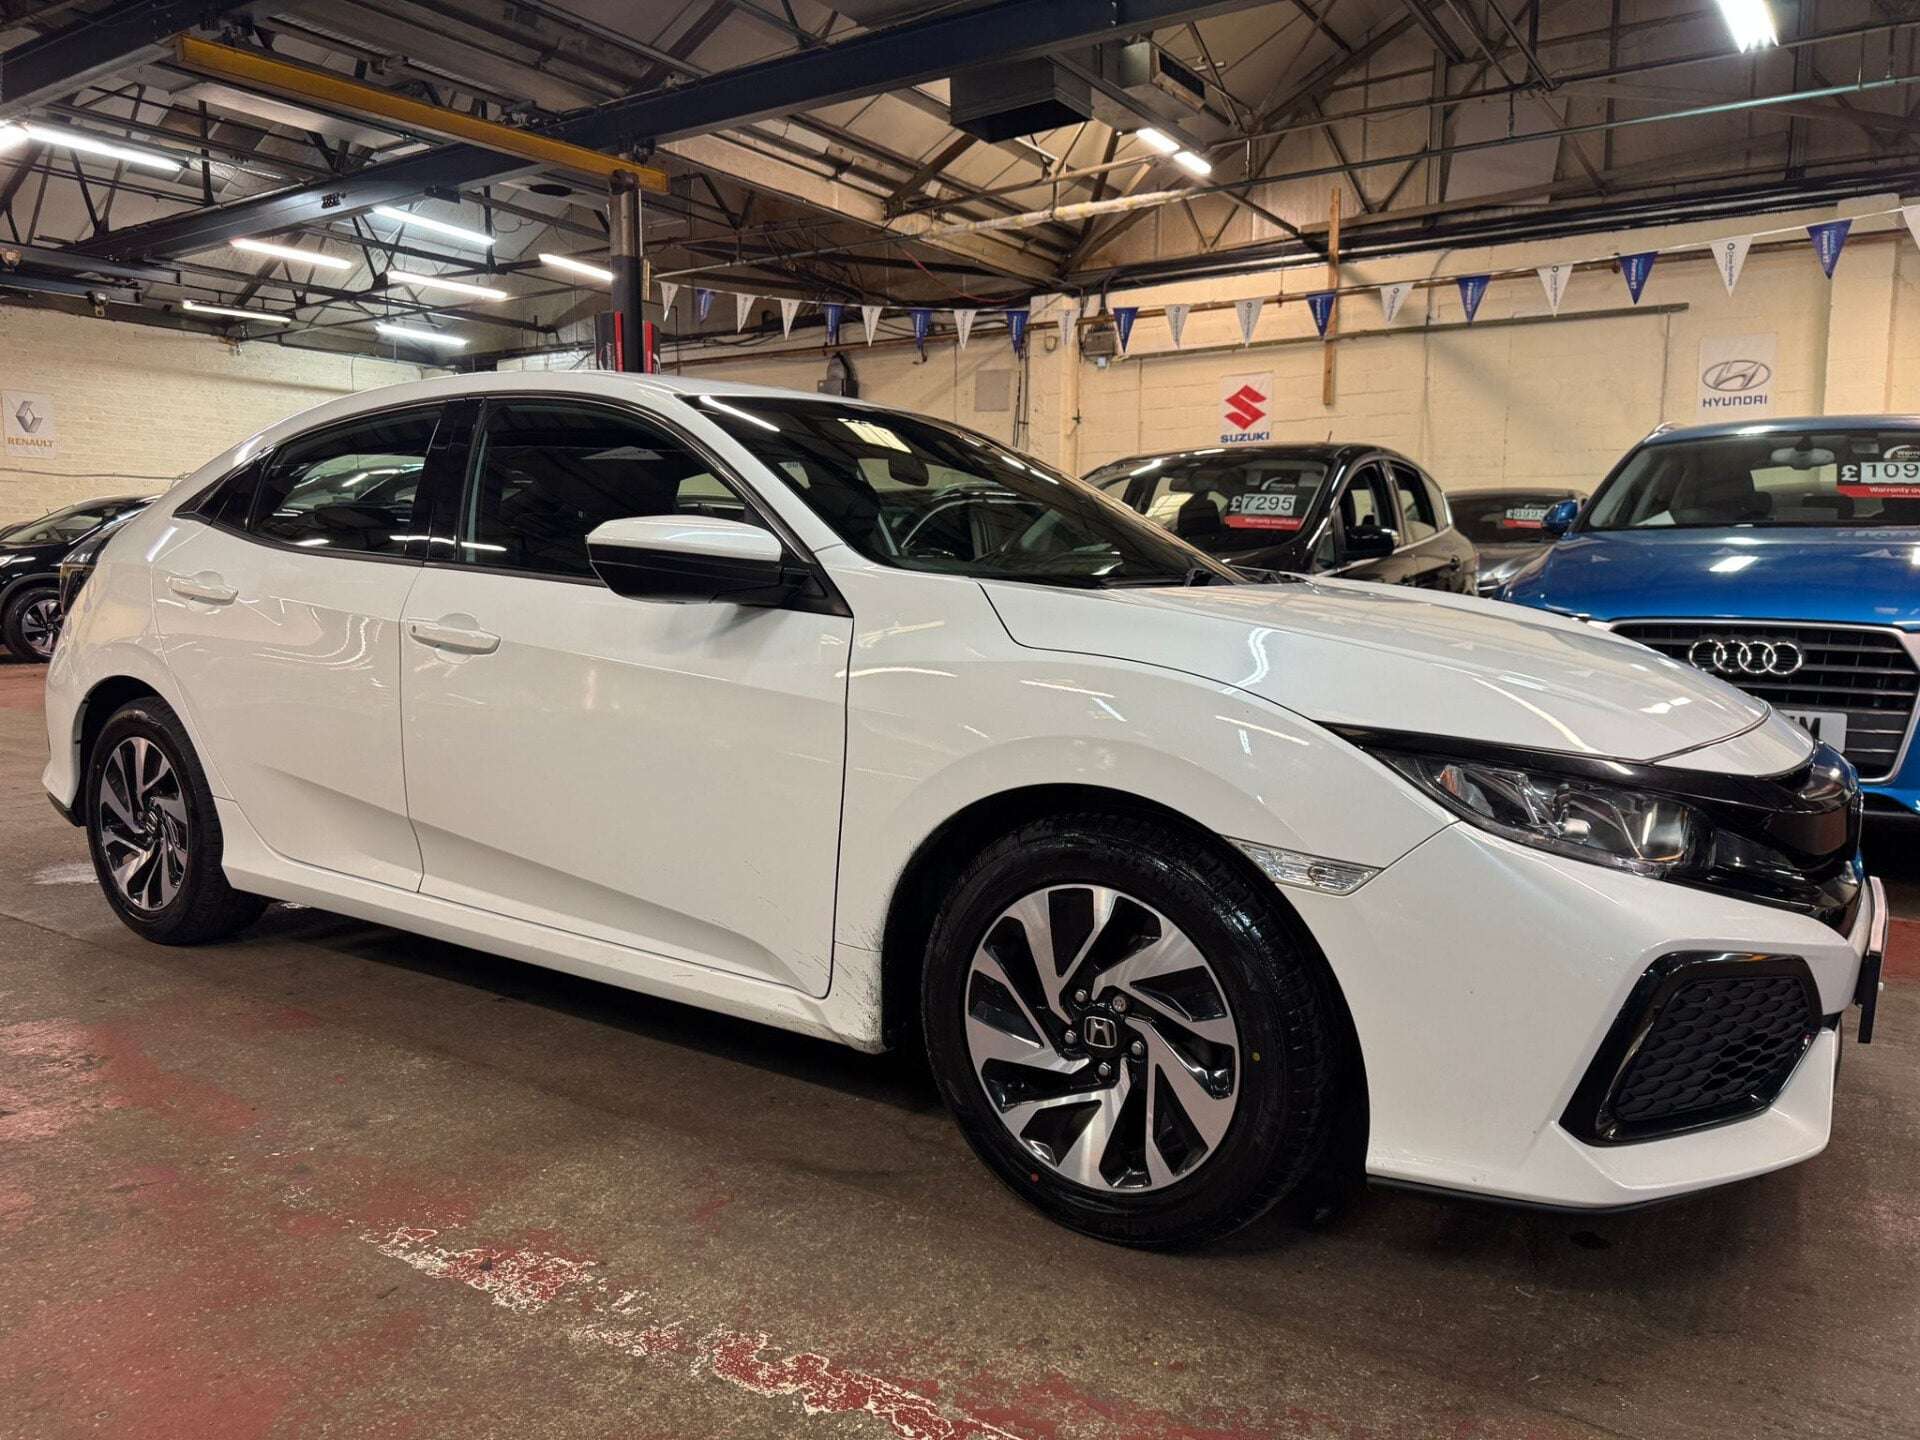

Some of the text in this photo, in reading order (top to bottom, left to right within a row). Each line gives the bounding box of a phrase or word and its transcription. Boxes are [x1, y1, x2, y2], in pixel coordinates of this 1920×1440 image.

[1702, 395, 1768, 408] HYUNDAI
[7, 436, 54, 448] RENAULT
[1220, 431, 1270, 443] SUZUKI
[1229, 495, 1294, 512] £7295
